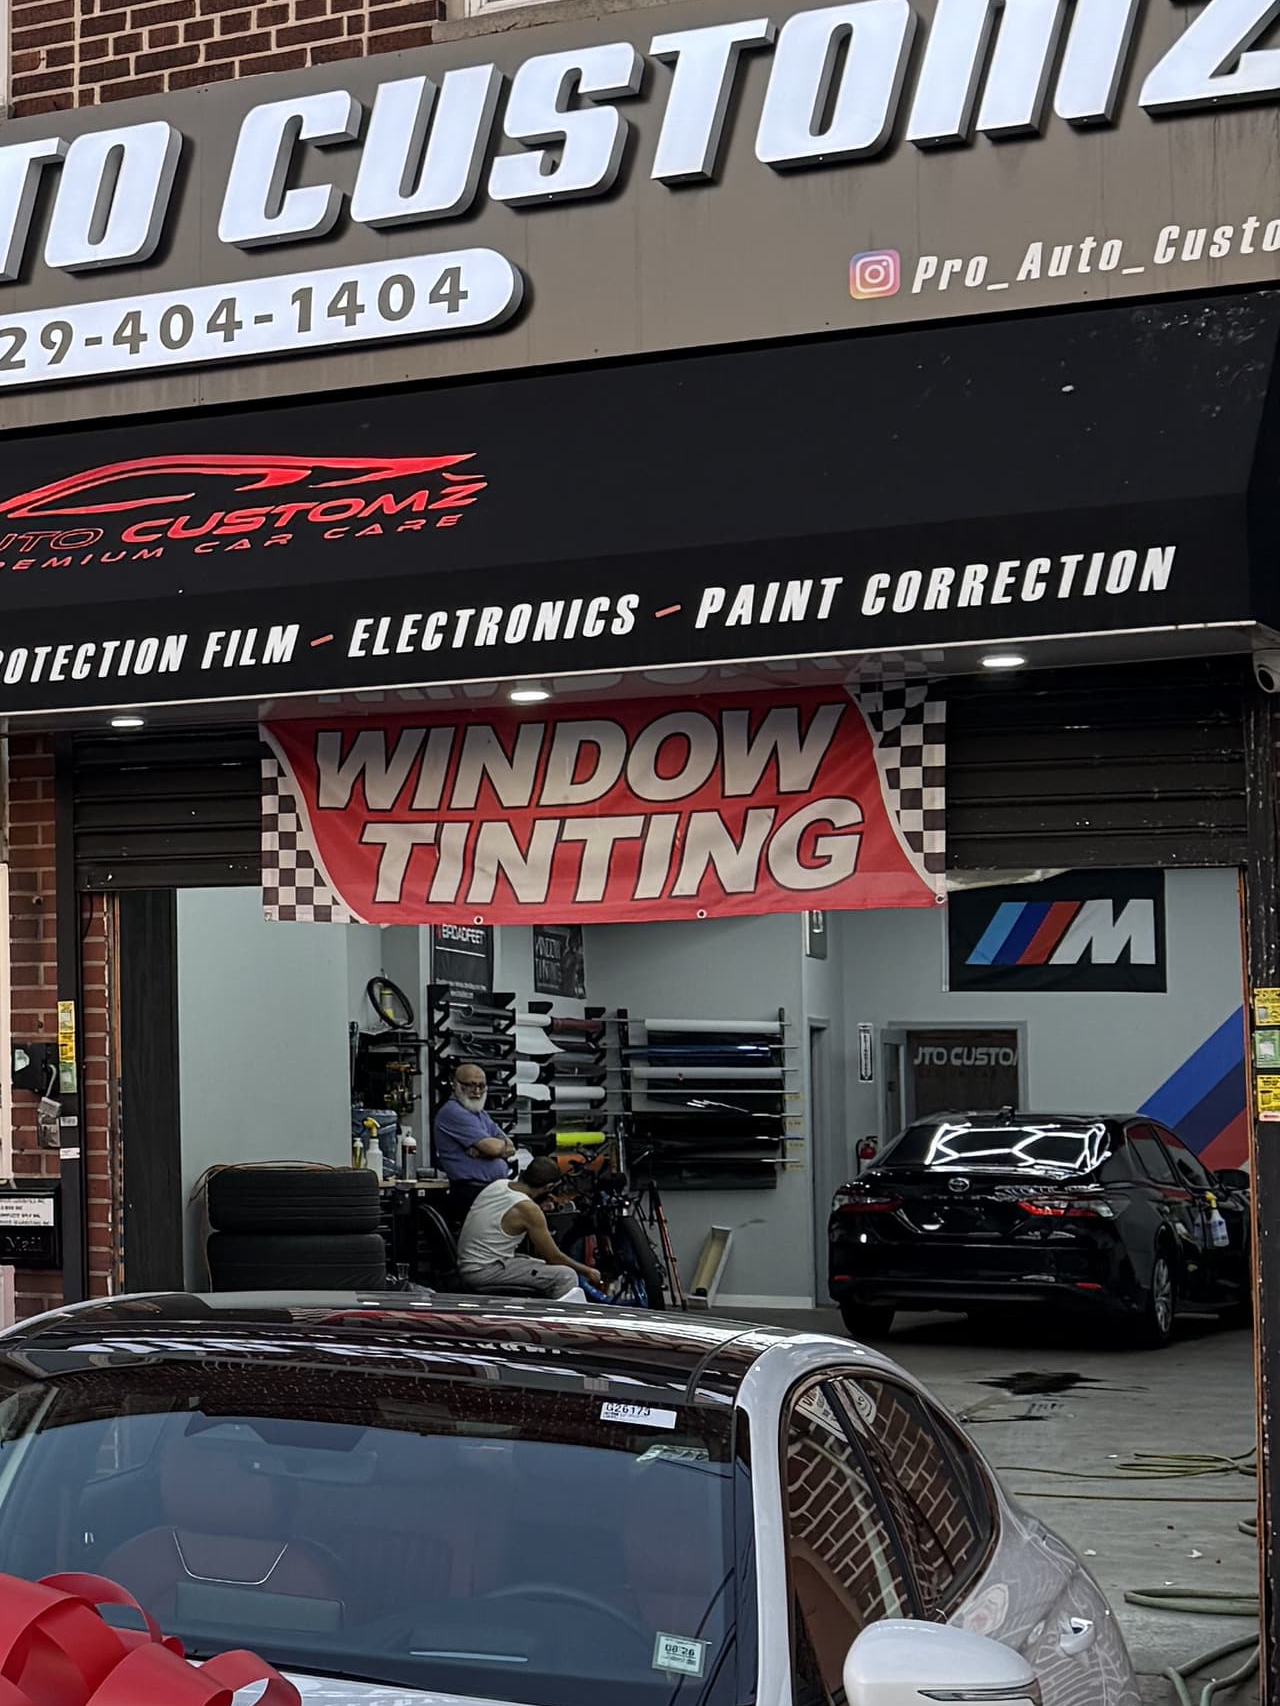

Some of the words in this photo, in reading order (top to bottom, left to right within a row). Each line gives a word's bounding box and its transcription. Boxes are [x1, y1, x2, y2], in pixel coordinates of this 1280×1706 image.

[121, 483, 488, 544] CUSTOMZ
[194, 533, 294, 554] CAR
[327, 513, 464, 542] CARE
[200, 624, 301, 670] FILM
[347, 593, 640, 658] ELECTRONICS
[694, 576, 844, 630] PAINT
[860, 545, 1177, 616] CORRECTION
[314, 703, 848, 812] WINDOW
[358, 796, 866, 905] TINTING
[950, 1046, 1018, 1067] CUSTO
